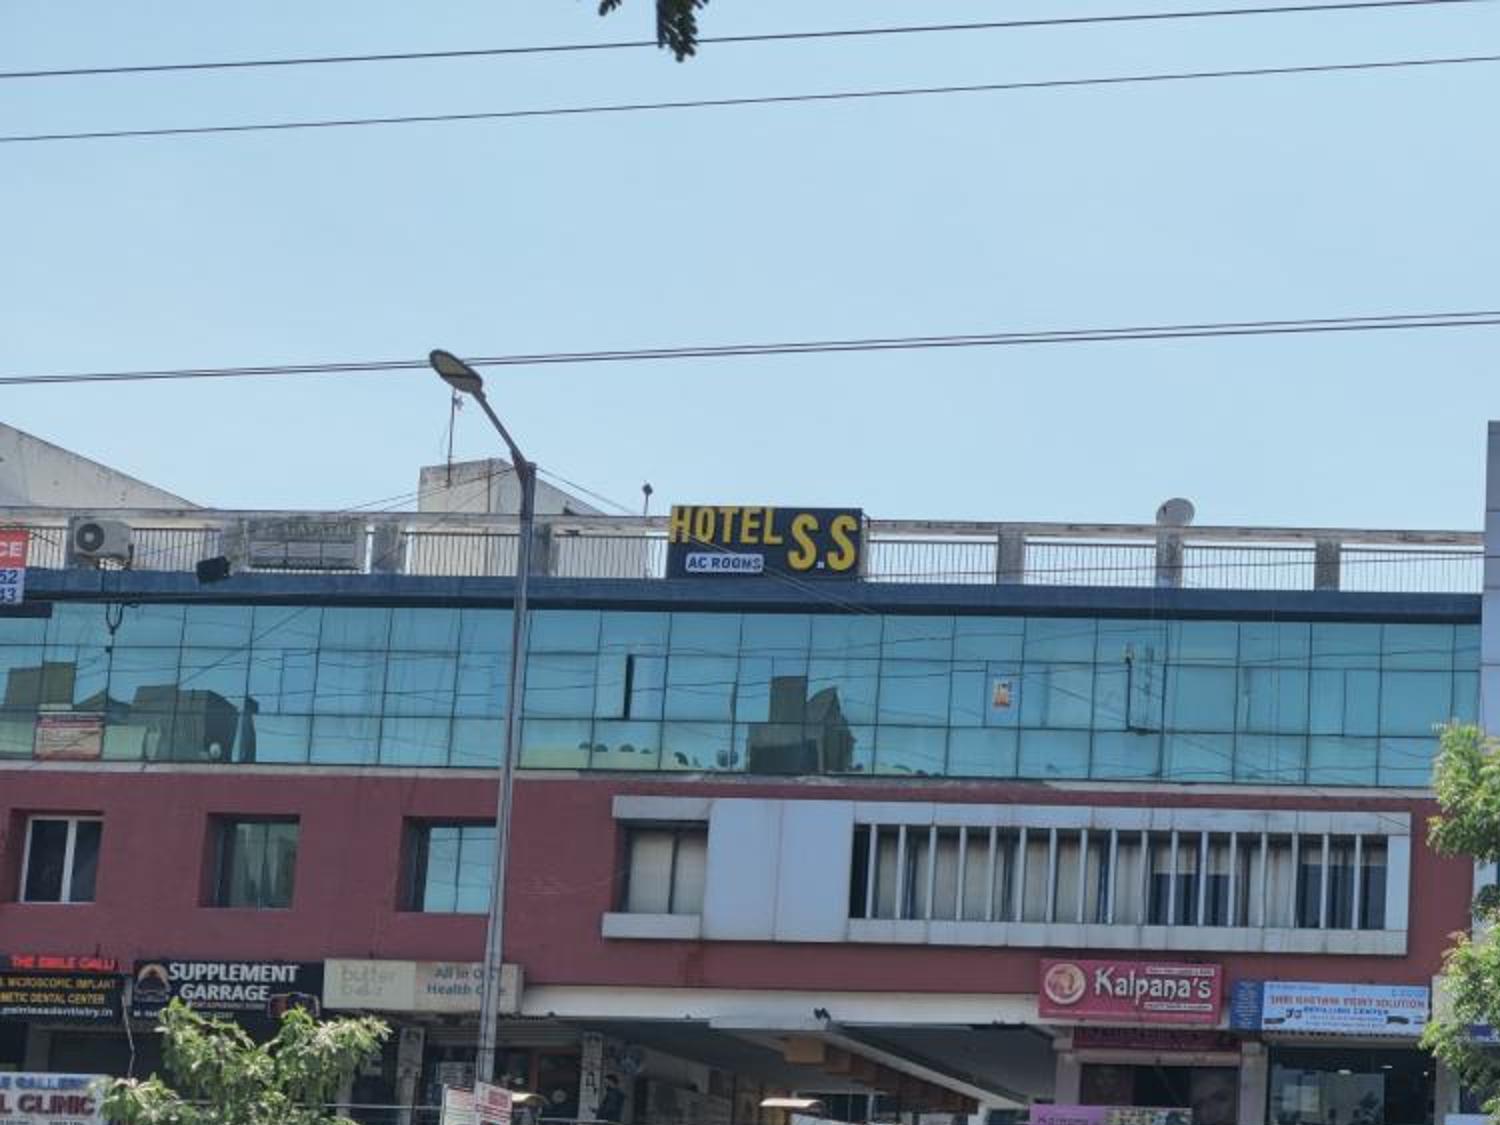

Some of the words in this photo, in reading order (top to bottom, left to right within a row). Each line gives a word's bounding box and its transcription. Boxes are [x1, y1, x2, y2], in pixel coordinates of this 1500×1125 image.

[671, 507, 783, 544] HOTEL
[687, 557, 707, 569] AC
[711, 556, 761, 570] ROOMS
[168, 962, 299, 983] SUPPLEMENT
[180, 984, 270, 1002] GARRAGE
[427, 983, 471, 995] Health
[1095, 966, 1212, 1005] Kalpana's
[30, 991, 65, 1005] DENTAL
[67, 992, 105, 1005] CENTER
[1376, 999, 1425, 1010] SOLUTION
[18, 1092, 95, 1116] CLINIC
